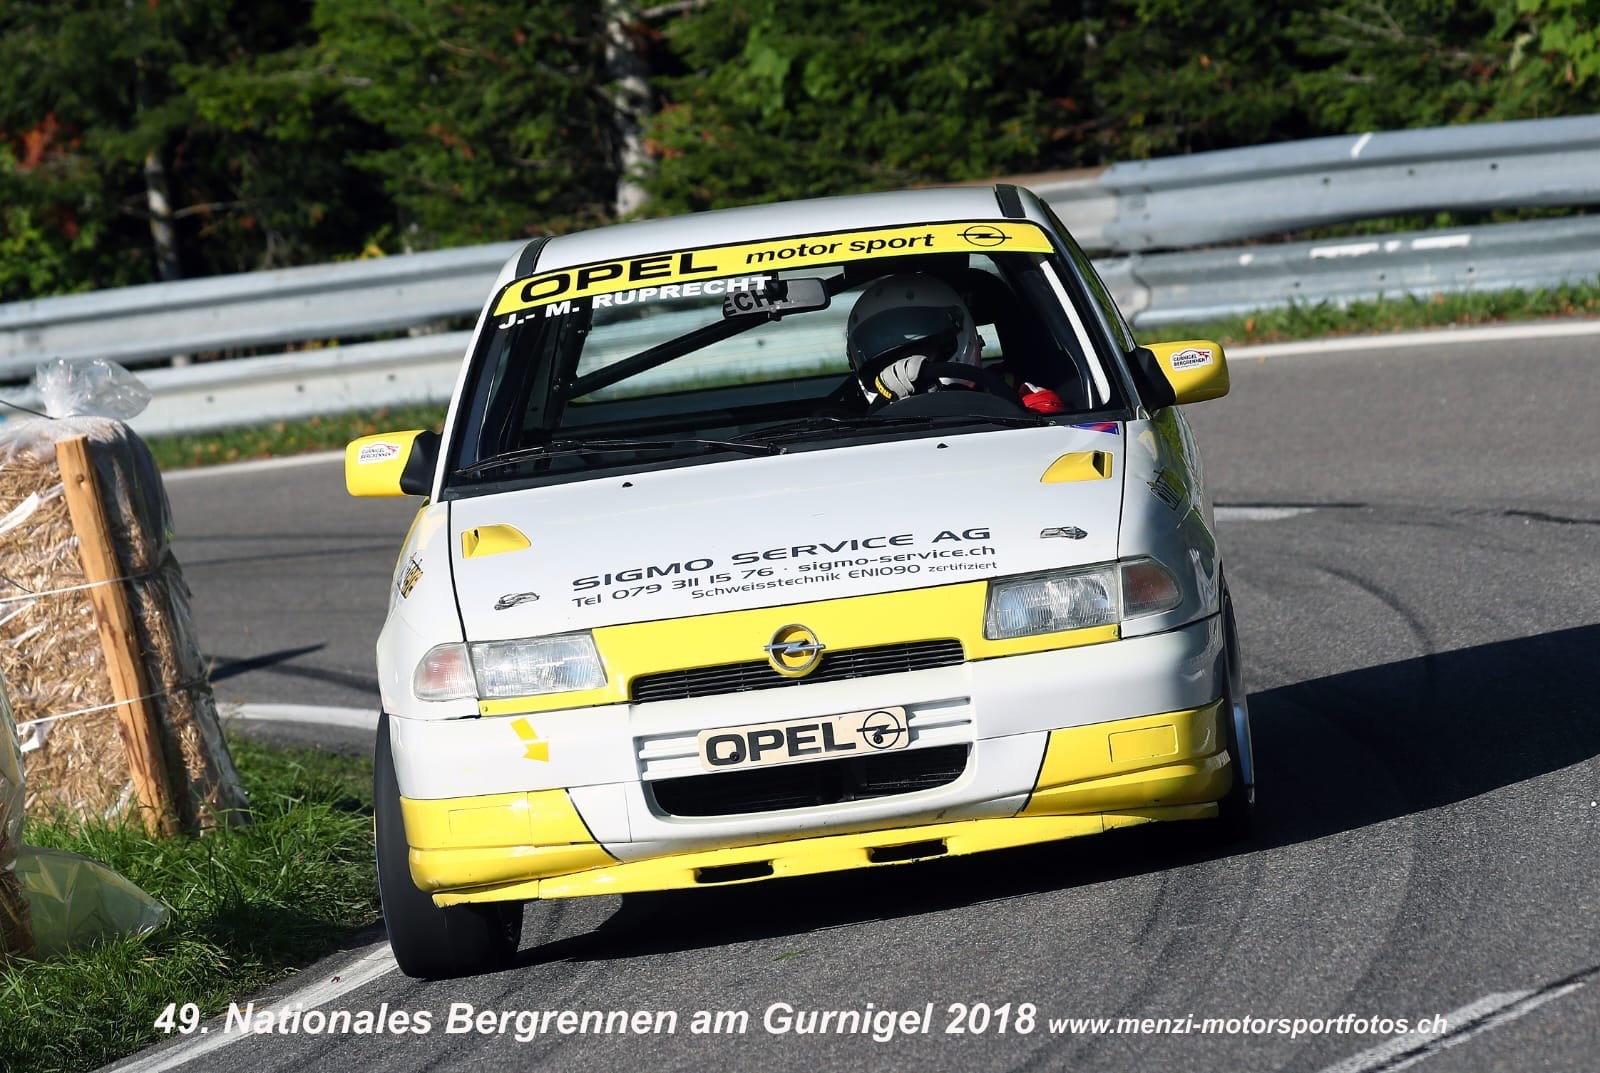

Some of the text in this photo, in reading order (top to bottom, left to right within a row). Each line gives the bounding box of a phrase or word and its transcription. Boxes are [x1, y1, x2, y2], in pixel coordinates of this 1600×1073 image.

[521, 233, 935, 303] OPEL motor sport
[545, 300, 580, 317] M.
[592, 275, 773, 309] RUPRECHT
[571, 546, 996, 608] Tel 079 311 15 76 sigmo-service.ch
[572, 527, 991, 592] SIGMO SERVICE AG
[691, 561, 998, 599] Schweisstechnik EN1090 zertifiziert
[706, 721, 857, 766] OPEL
